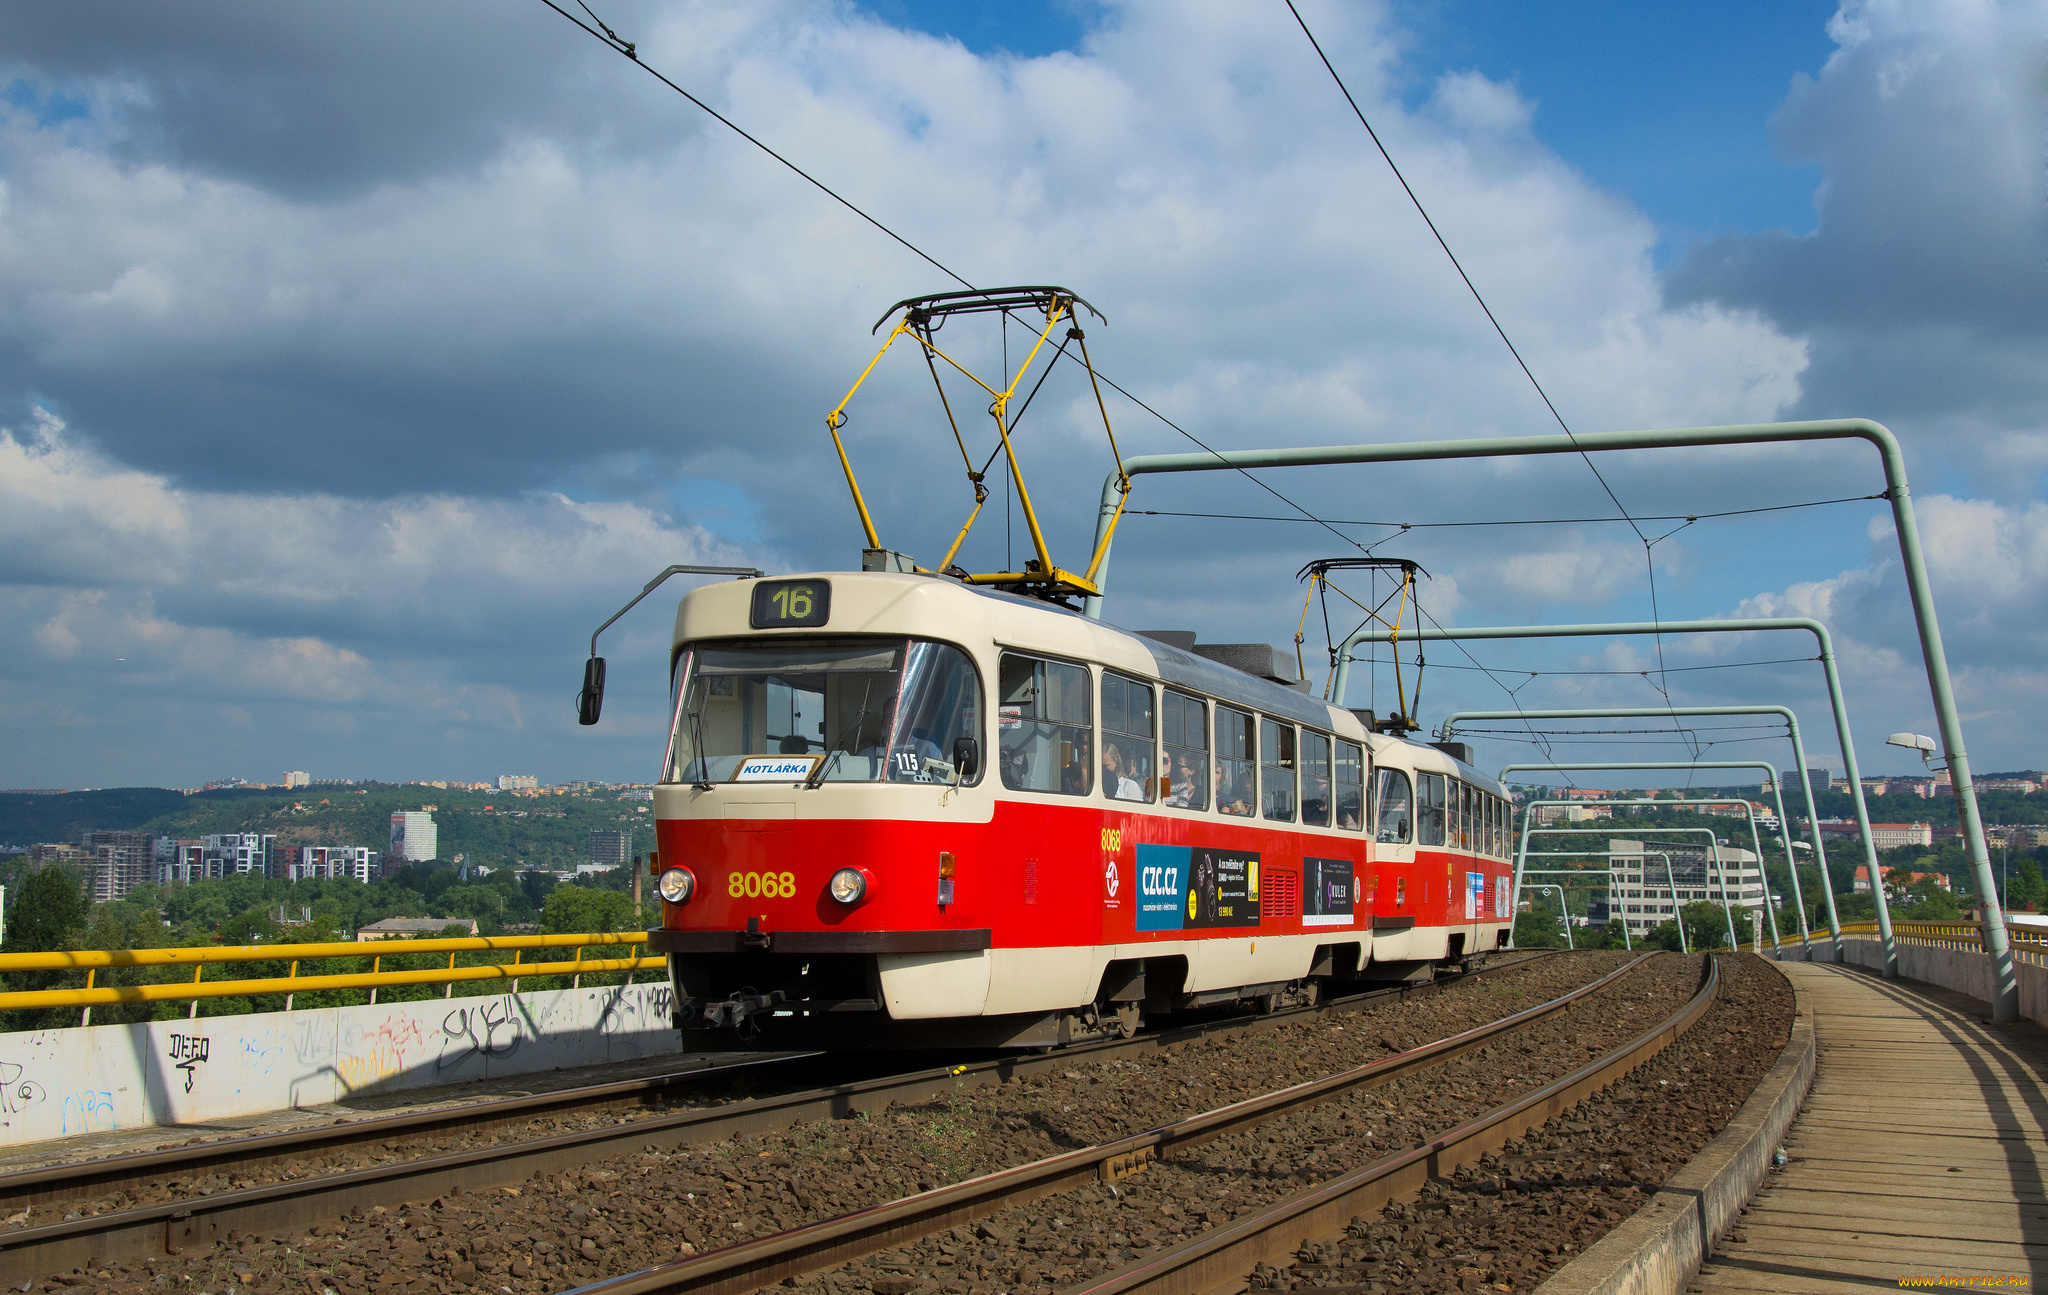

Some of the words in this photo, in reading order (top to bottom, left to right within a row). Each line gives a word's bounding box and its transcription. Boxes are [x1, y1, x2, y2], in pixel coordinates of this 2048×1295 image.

[772, 585, 813, 619] 16
[743, 762, 807, 774] KOTLÁŘKA
[895, 752, 919, 772] 115
[1101, 827, 1121, 852] 8068
[728, 871, 797, 898] 8068
[1142, 866, 1178, 896] CZC.CZ
